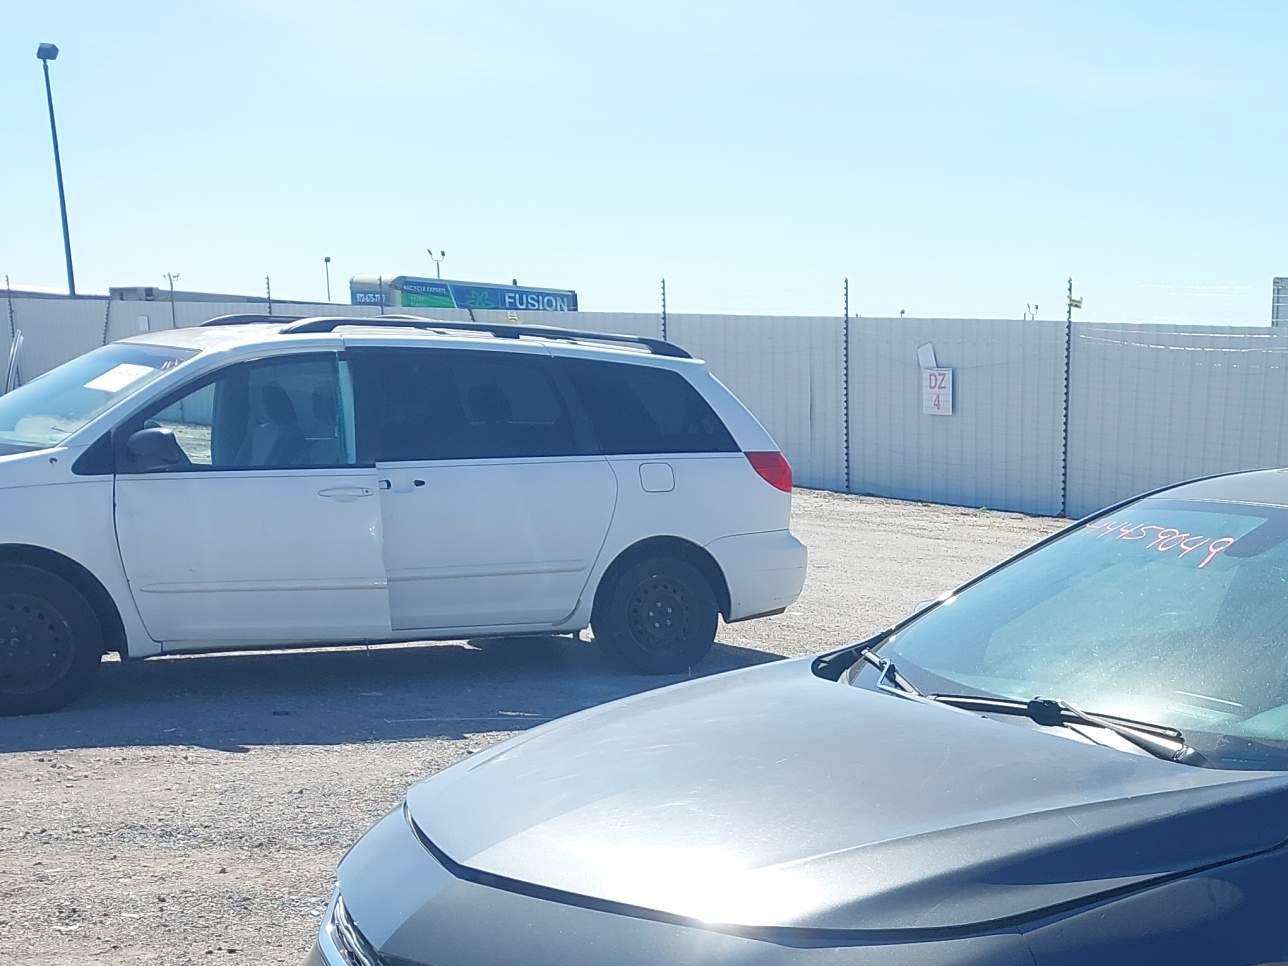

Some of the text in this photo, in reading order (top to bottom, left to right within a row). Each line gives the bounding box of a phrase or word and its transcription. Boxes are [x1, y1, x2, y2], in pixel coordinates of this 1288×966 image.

[504, 292, 568, 312] FUSION
[928, 372, 946, 390] DZ
[933, 393, 942, 410] 4
